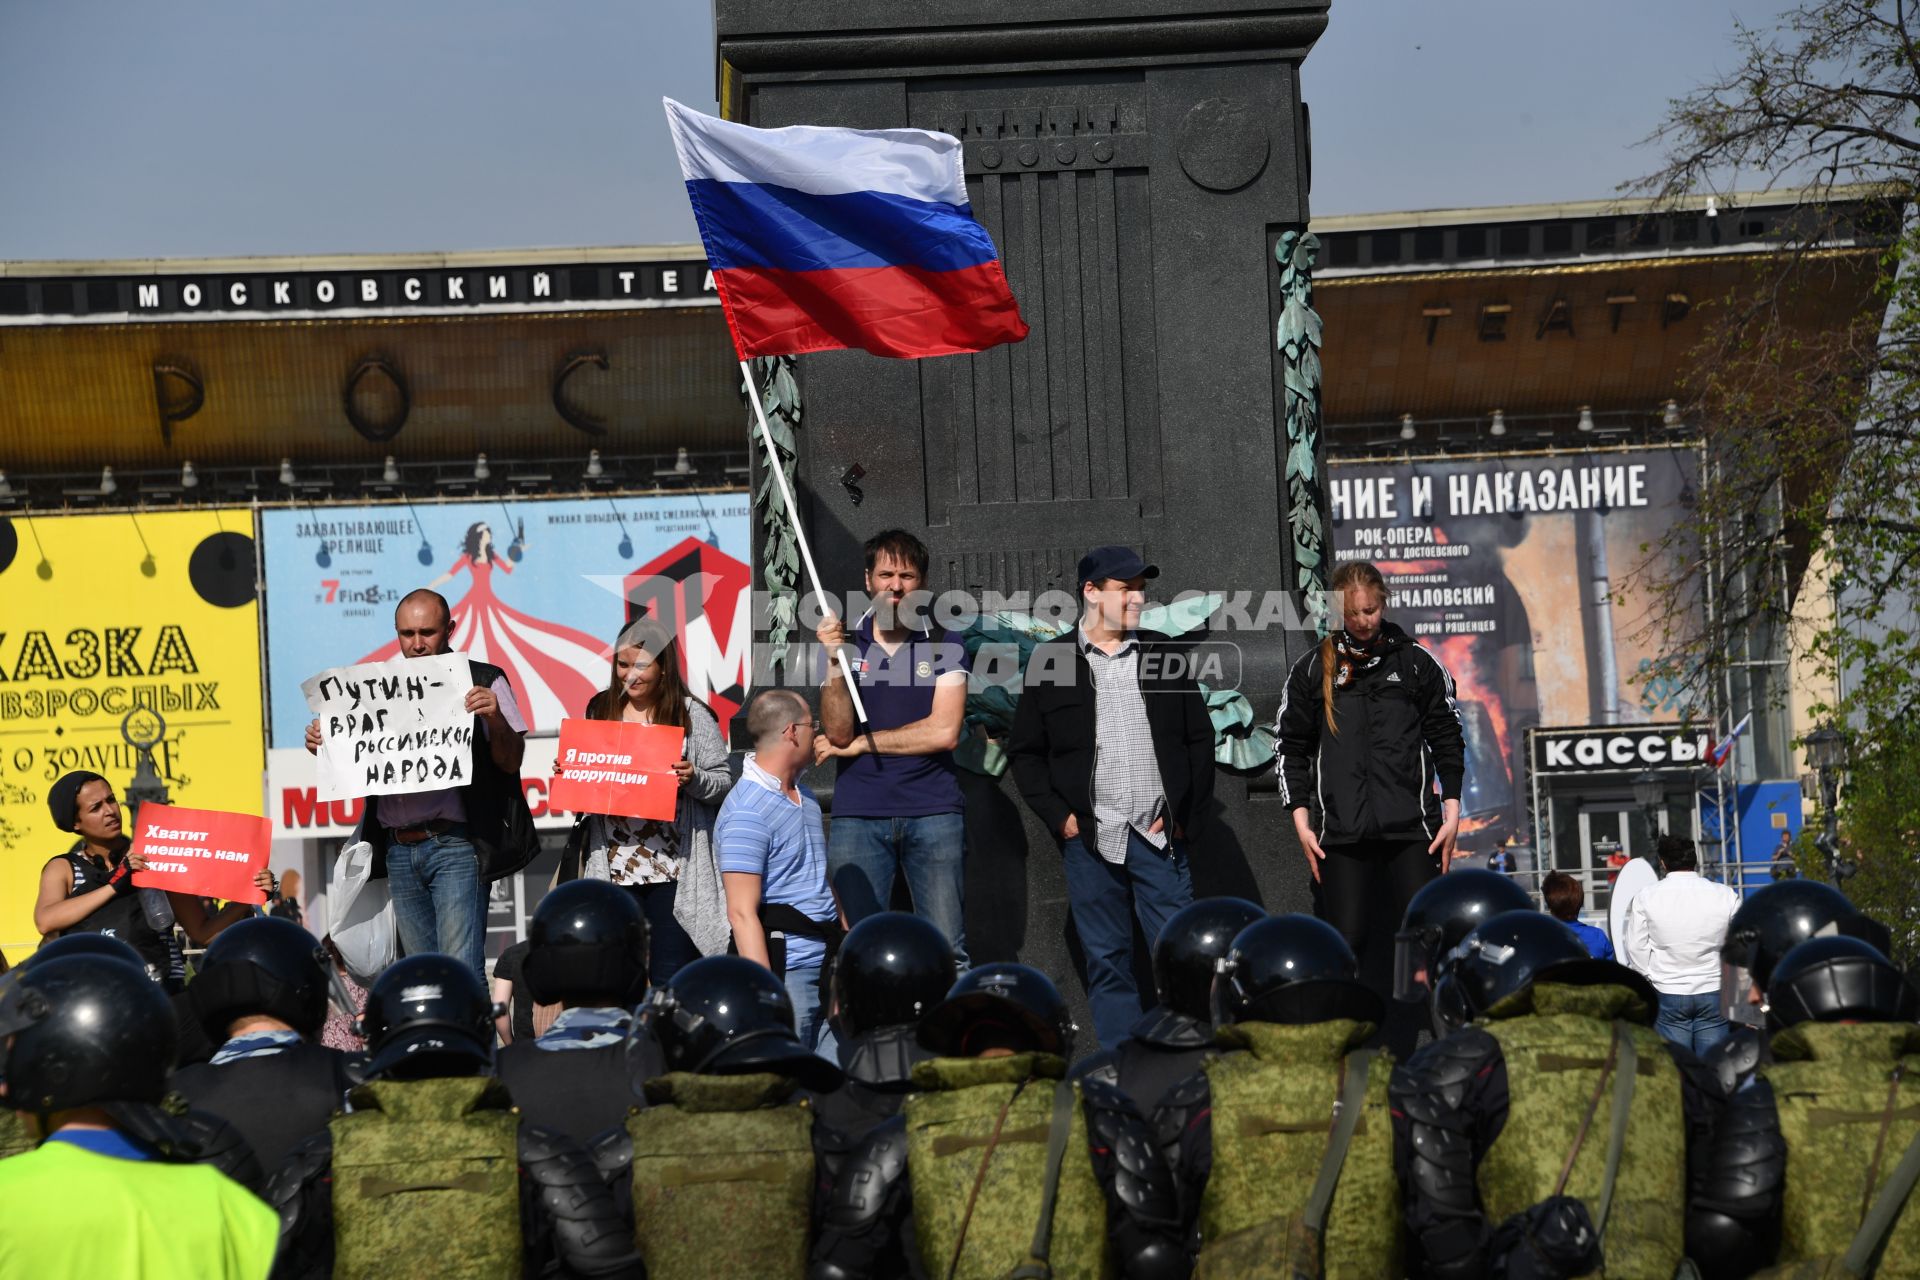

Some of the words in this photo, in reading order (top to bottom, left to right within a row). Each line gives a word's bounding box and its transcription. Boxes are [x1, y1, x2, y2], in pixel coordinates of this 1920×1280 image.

[138, 272, 550, 307] МОСКОВСКИЙ
[1411, 476, 1432, 518] И
[1449, 465, 1648, 516] НАКАЗАНИЕ
[296, 520, 415, 538] ЗАХВАТЫВАЮЩЕЕ
[1355, 526, 1434, 546] РОК-ОПЕРА
[1335, 548, 1372, 561] РОМАНУ
[1403, 544, 1470, 559] ДОСТОЕВСКОГО
[1415, 621, 1442, 634] ЮРИЙ
[1445, 619, 1496, 634] РЯШЕНЦЕВ
[1, 682, 220, 720] ВЗРОСЛЫХ
[330, 709, 387, 738] ВРАГ
[565, 748, 577, 763] Я
[578, 752, 632, 766] против
[366, 754, 463, 785] НАРОДА
[562, 769, 648, 785] коррупции
[145, 824, 208, 842] Хватит
[144, 844, 212, 859] мешать
[215, 850, 249, 863] нам
[145, 861, 188, 873] жить
